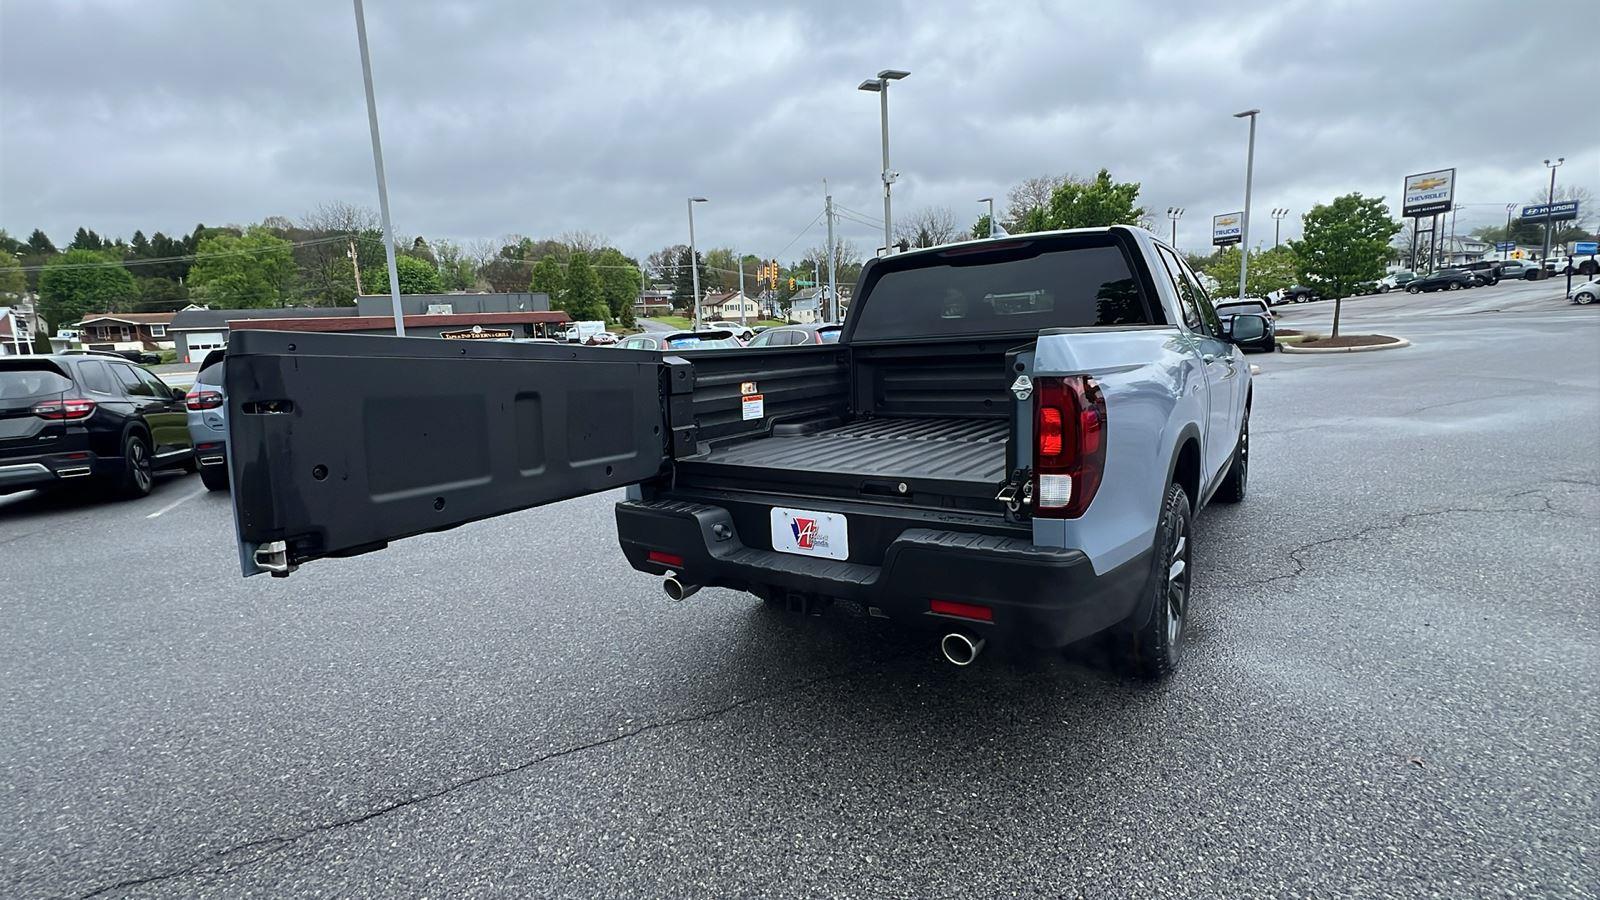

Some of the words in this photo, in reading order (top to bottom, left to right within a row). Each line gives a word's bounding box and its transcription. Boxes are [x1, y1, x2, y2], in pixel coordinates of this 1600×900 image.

[1407, 191, 1448, 203] CHEVROLET
[1539, 203, 1575, 214] HYUNDAI
[1215, 227, 1240, 236] TRUCKS
